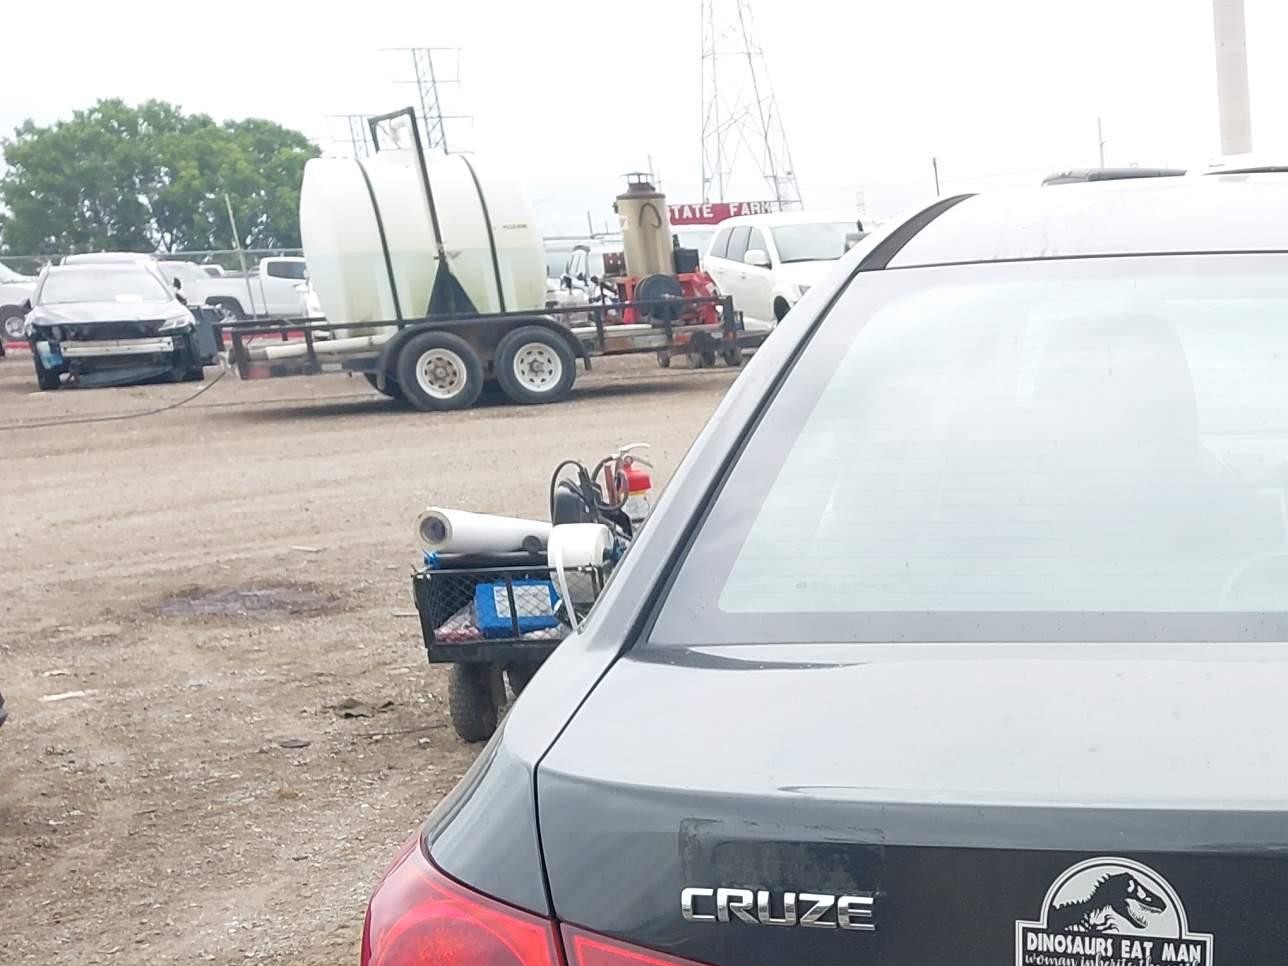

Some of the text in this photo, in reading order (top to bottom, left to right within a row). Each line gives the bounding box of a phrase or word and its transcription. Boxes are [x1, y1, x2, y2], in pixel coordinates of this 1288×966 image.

[728, 202, 772, 217] FARM
[681, 887, 876, 931] CRUZE
[1026, 932, 1202, 963] DINOSAURS EAT MAN
